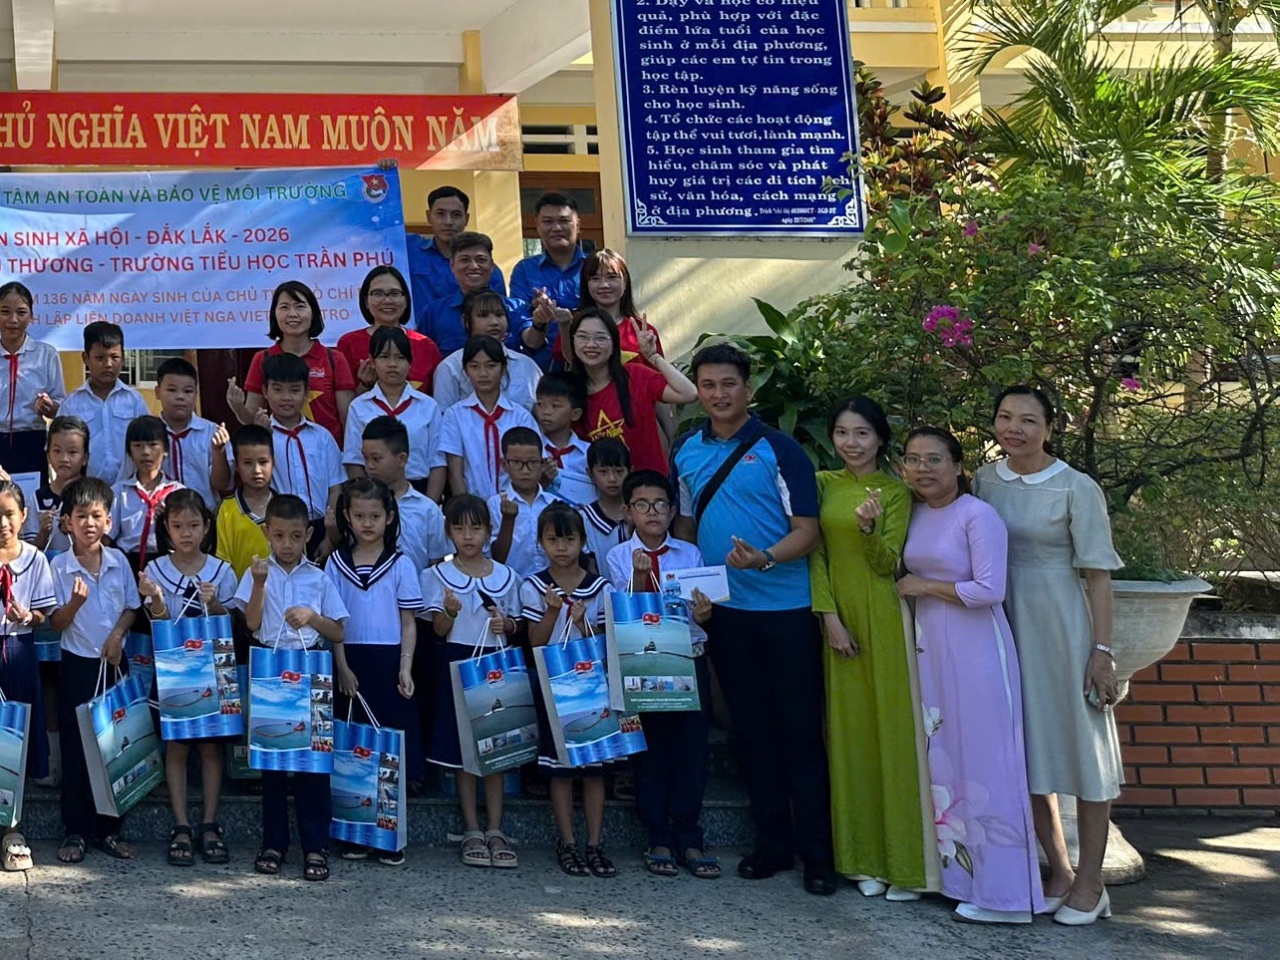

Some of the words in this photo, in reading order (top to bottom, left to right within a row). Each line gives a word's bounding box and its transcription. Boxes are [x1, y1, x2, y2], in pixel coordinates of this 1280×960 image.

[637, 12, 672, 22] quả,
[680, 12, 711, 22] phù
[720, 11, 750, 22] hợp
[757, 11, 782, 20] với
[790, 11, 820, 22] đặc
[639, 24, 679, 34] điểm
[685, 26, 711, 34] lứa
[720, 24, 752, 34] tuổi
[760, 25, 788, 34] của
[796, 26, 825, 36] học
[639, 41, 673, 50] sinh
[680, 40, 690, 50] ở
[696, 39, 726, 50] mỗi
[733, 41, 758, 51] địa
[764, 41, 828, 51] phương,
[641, 56, 676, 66] giúp
[681, 55, 707, 64] các
[741, 56, 759, 66] tự
[763, 56, 785, 64] tin
[790, 56, 832, 66] trong
[642, 71, 669, 81] học
[674, 71, 704, 81] tập.
[643, 85, 654, 94] 3.
[660, 85, 689, 94] Rèn
[694, 85, 735, 96] luyện
[739, 85, 757, 95] kỹ
[763, 85, 799, 96] năng
[803, 84, 838, 96] sống
[644, 100, 671, 109] cho
[676, 100, 704, 110] học
[708, 100, 745, 109] sinh.
[645, 115, 657, 124] 4.
[661, 114, 681, 124] Tổ
[686, 115, 723, 124] chức
[727, 115, 753, 124] các
[757, 115, 791, 125] hoạt
[795, 115, 832, 125] động
[46, 105, 147, 149] NGHĨA
[153, 103, 230, 157] VIỆT
[240, 114, 310, 150] NAM
[321, 107, 414, 151] MUÔN
[426, 106, 501, 153] NĂM
[647, 146, 659, 155] 5.
[665, 146, 694, 156] Học
[699, 146, 732, 155] sinh
[737, 146, 776, 155] tham
[781, 144, 804, 156] gia
[810, 146, 835, 155] tìm
[648, 159, 687, 171] hiểu,
[692, 161, 733, 170] chăm
[738, 161, 764, 170] sóc
[769, 161, 787, 170] và
[792, 161, 828, 171] phát
[649, 176, 677, 186] huy
[683, 176, 706, 186] giá
[712, 176, 731, 187] trị
[736, 176, 762, 185] các
[767, 176, 781, 185] di
[787, 175, 817, 185] tích
[822, 175, 850, 185] lch
[5, 188, 45, 204] TÂM
[49, 191, 70, 203] AN
[75, 187, 124, 203] TOÀN
[130, 185, 151, 202] VÀ
[158, 184, 194, 202] BẢO
[199, 184, 220, 204] VỆ
[226, 184, 260, 201] MÔI
[267, 184, 346, 199] TRƯỜNG
[650, 190, 672, 202] sử,
[677, 191, 706, 200] văn
[711, 191, 743, 202] hóa,
[753, 191, 789, 200] cách
[794, 191, 836, 202] mạng
[652, 205, 661, 215] ở
[666, 206, 690, 217] địa
[696, 206, 758, 217] phương.
[14, 232, 59, 246] SINH
[64, 228, 89, 245] XÃ
[96, 227, 129, 249] HỘI
[147, 222, 185, 244] ĐẮK
[191, 222, 227, 244] LẮK
[243, 227, 290, 243] 2026
[7, 257, 93, 273] THƯƠNG
[110, 258, 194, 272] TRƯỜNG
[200, 250, 241, 270] TIỂU
[248, 254, 290, 273] HỌC
[295, 246, 346, 268] TRẦN
[353, 248, 395, 267] PHÚ
[43, 293, 68, 305] 136
[72, 290, 105, 304] NĂM
[109, 290, 148, 304] NGÀY
[152, 292, 187, 303] SINH
[193, 287, 221, 302] CỦA
[226, 286, 257, 302] CHỦ
[328, 285, 353, 299] CHÍ
[45, 312, 72, 328] LẬP
[112, 312, 165, 324] DOANH
[170, 309, 201, 325] VIỆT
[204, 311, 236, 323] NGA
